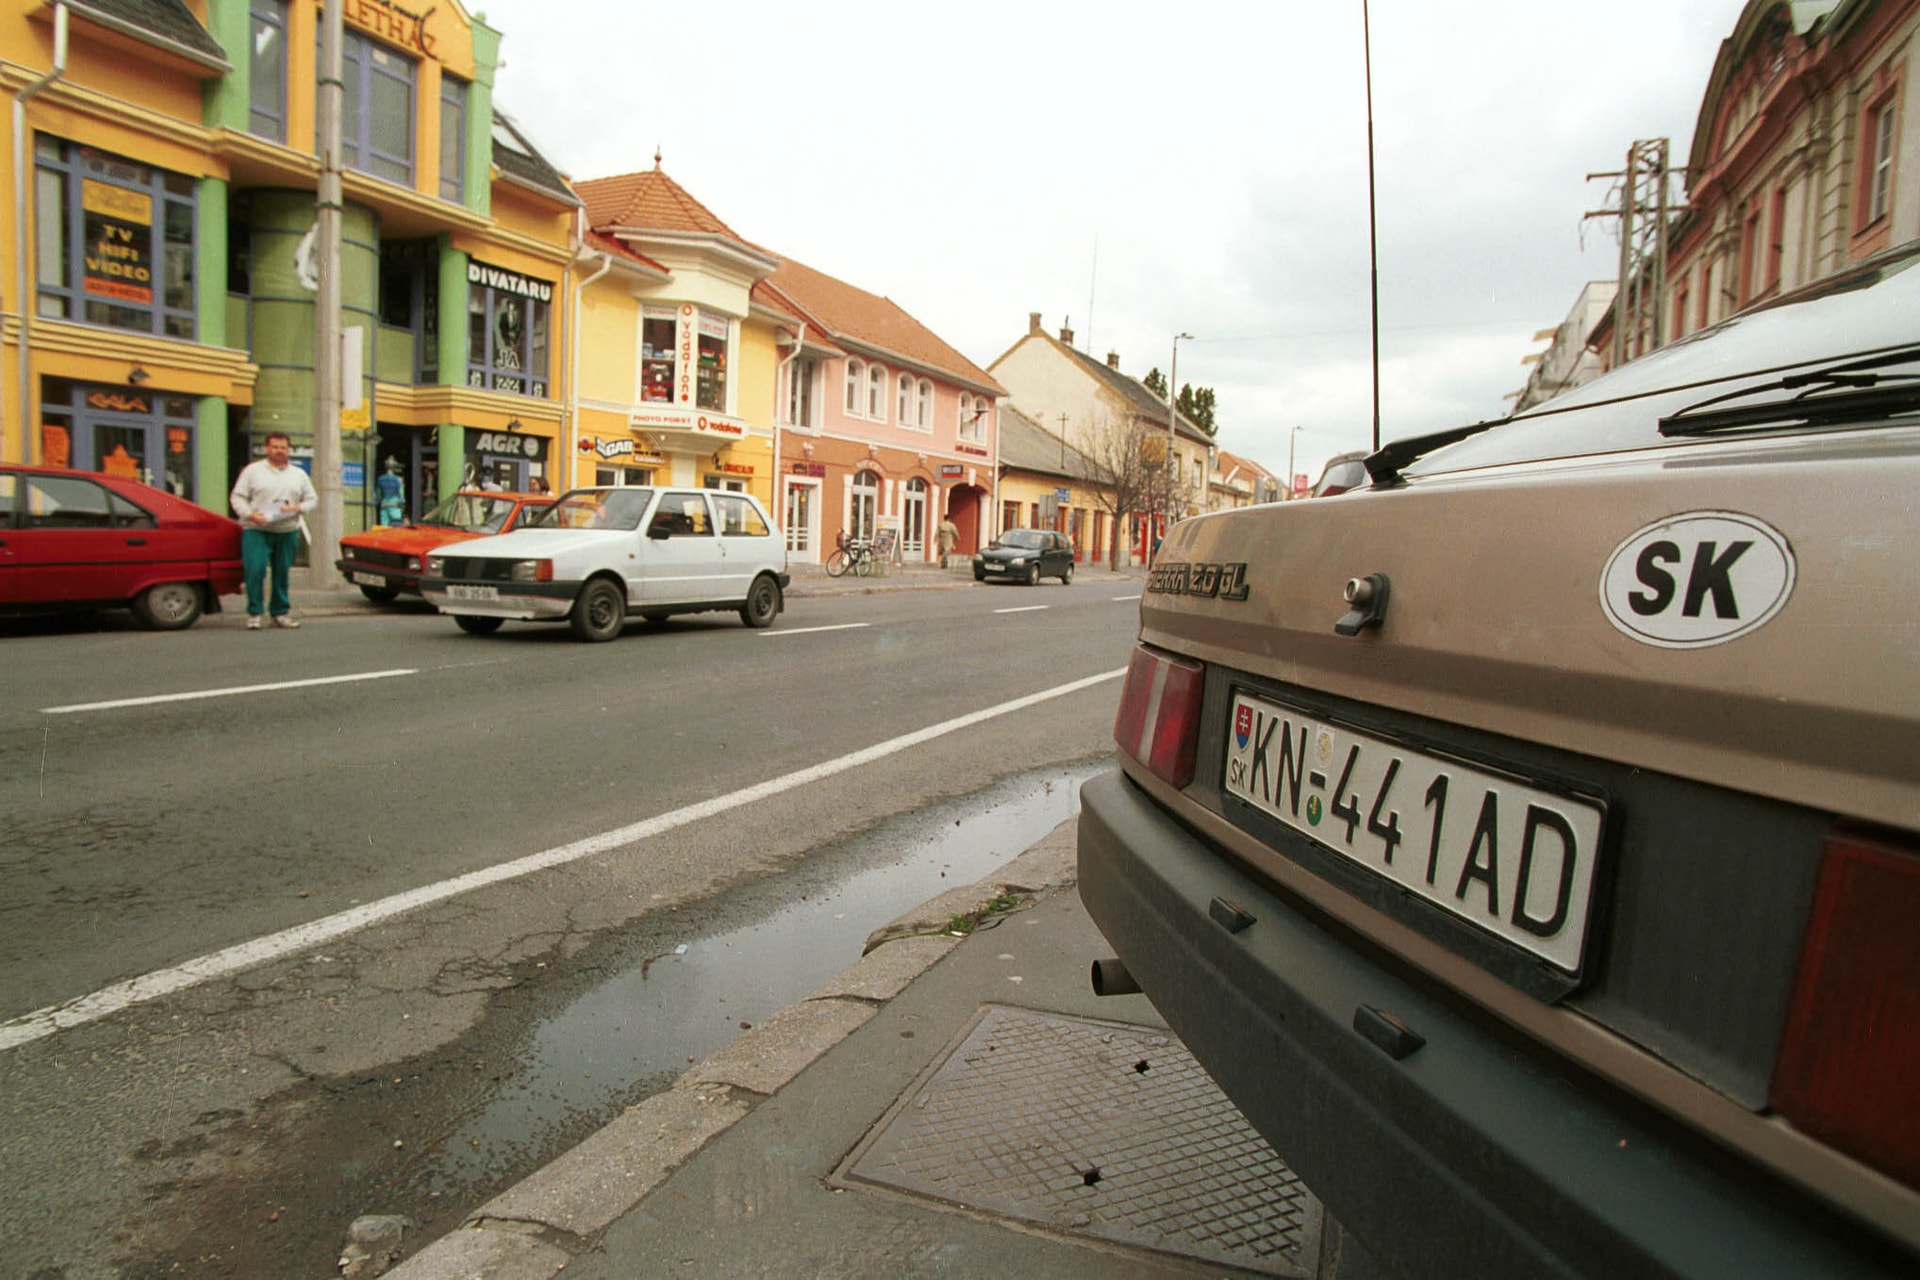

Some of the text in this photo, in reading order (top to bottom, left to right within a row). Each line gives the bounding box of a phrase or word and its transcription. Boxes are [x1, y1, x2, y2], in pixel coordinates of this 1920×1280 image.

[103, 224, 133, 242] TV
[97, 241, 139, 263] HIFI
[85, 257, 150, 282] VIDEO
[632, 415, 662, 423] PHOTO
[708, 421, 743, 435] vodafone
[1627, 540, 1756, 620] SK
[1230, 757, 1248, 789] SK
[1250, 710, 1577, 939] KN-441AD
